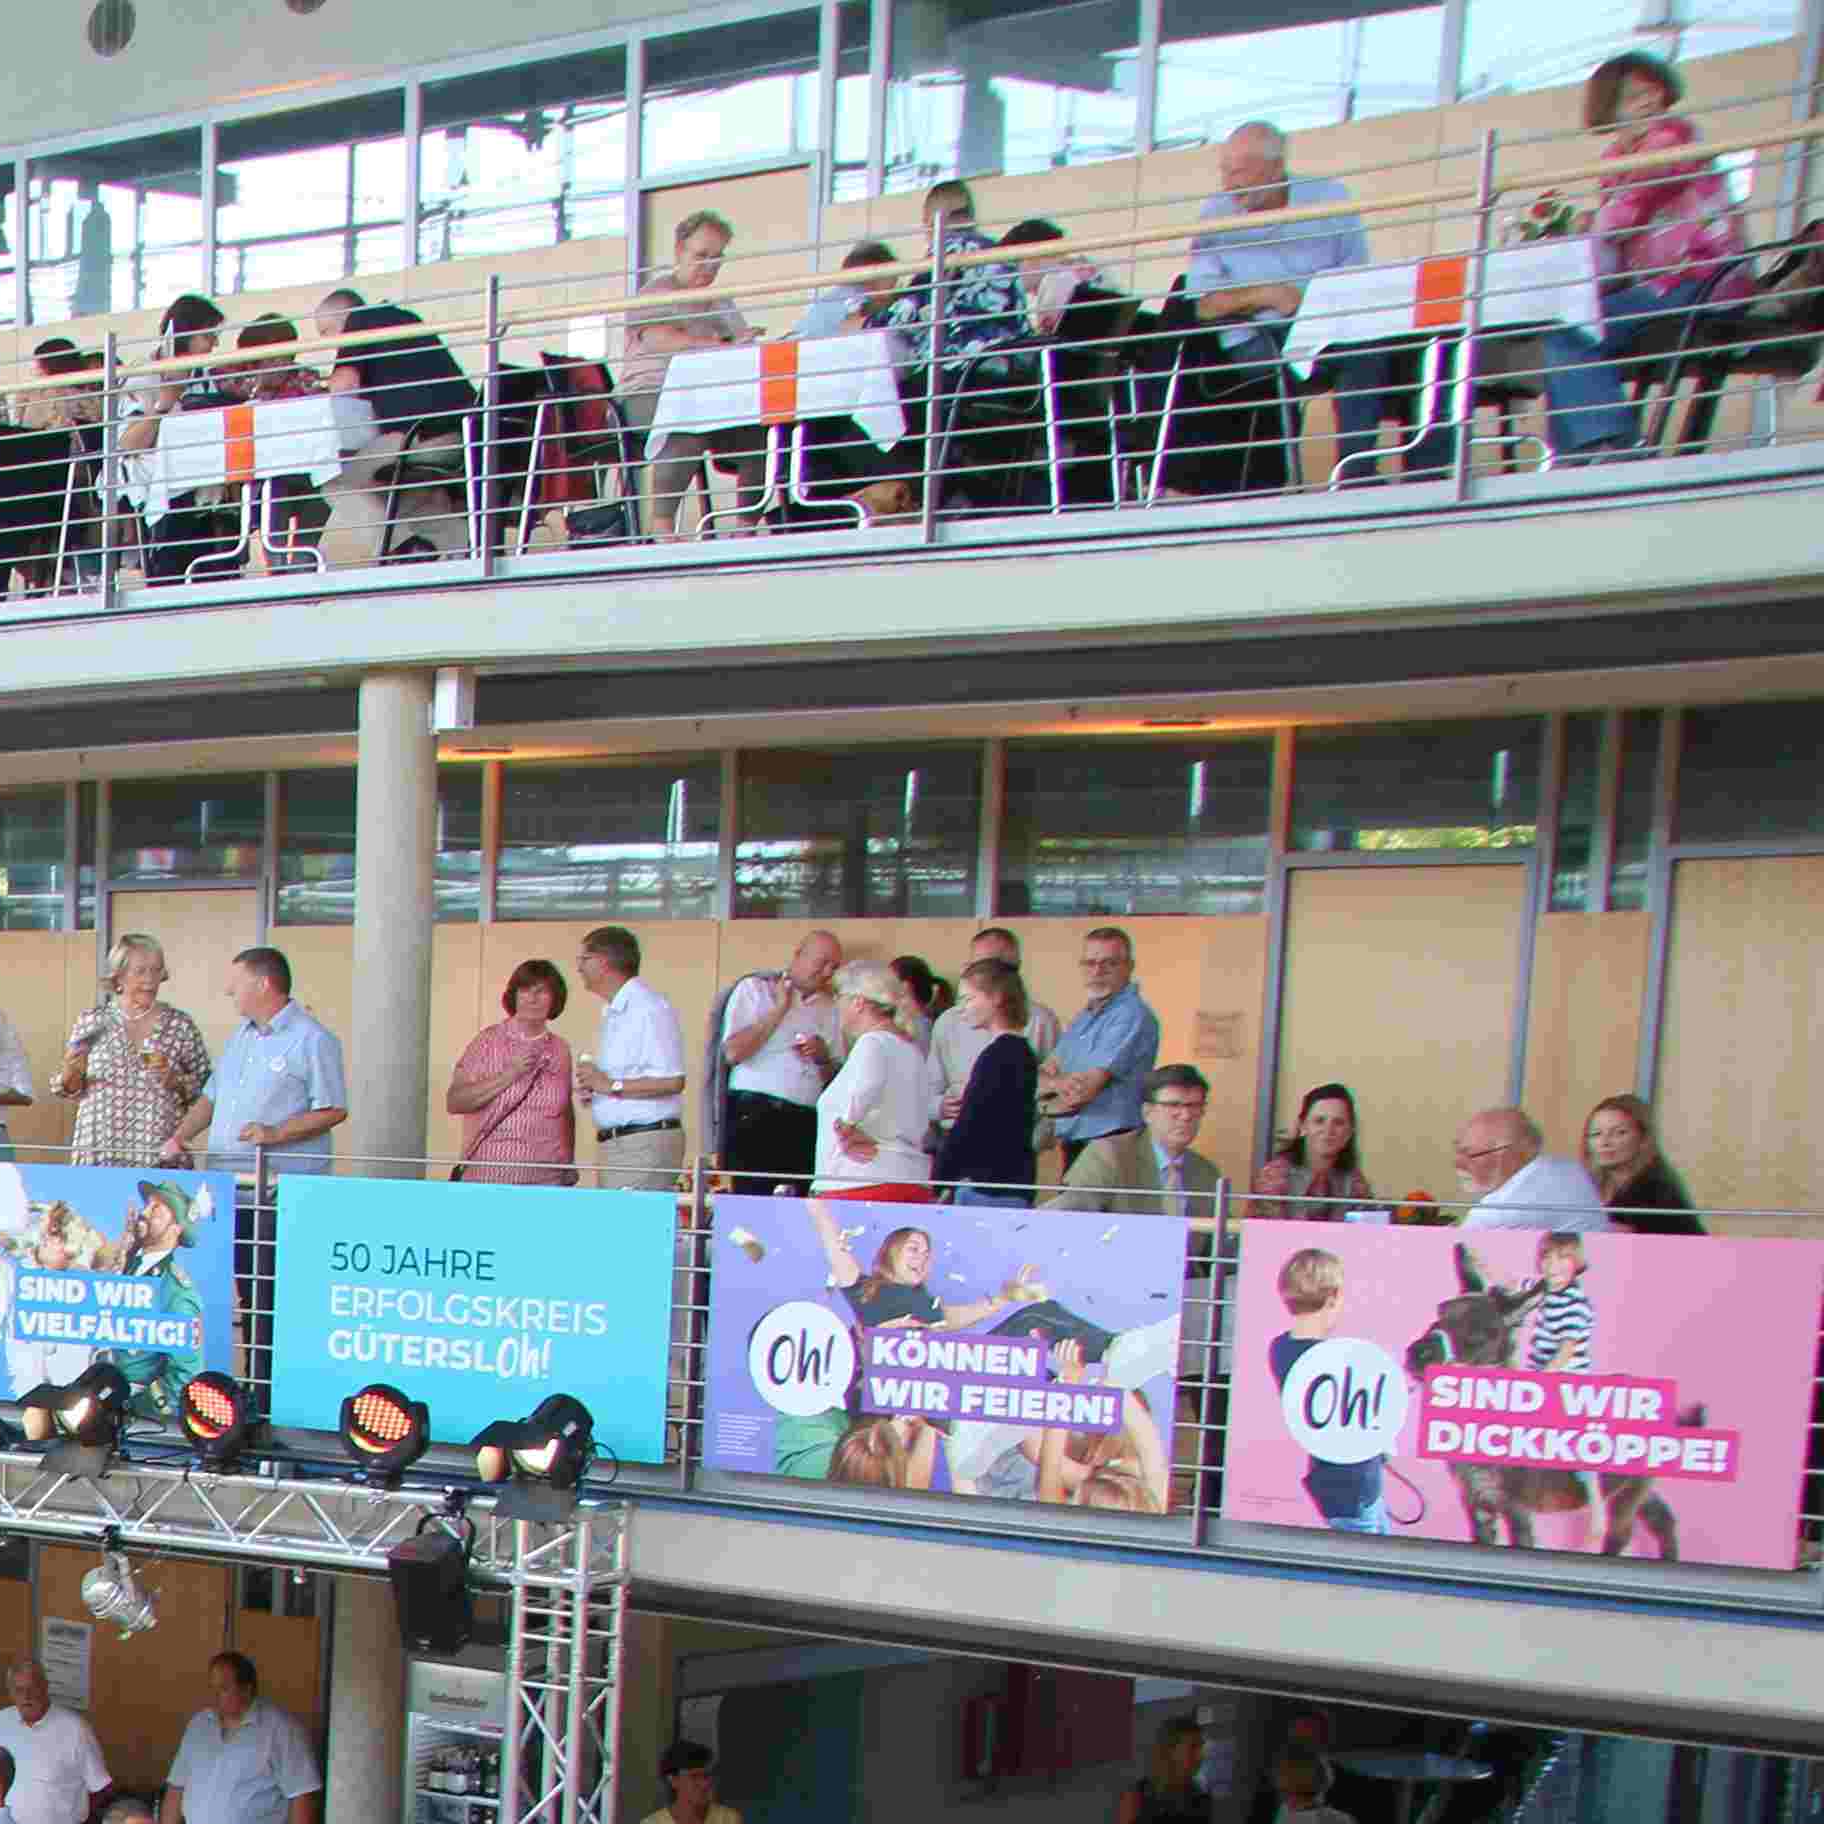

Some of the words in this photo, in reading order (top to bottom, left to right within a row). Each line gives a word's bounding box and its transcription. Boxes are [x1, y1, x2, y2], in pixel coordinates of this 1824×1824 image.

[330, 1242, 371, 1273] 50
[381, 1244, 496, 1281] JAHRE
[18, 1276, 87, 1303] SIND
[94, 1281, 152, 1308] WIR
[328, 1283, 609, 1336] ERFOLGSKREIS
[18, 1311, 187, 1346] VIELFÄLTIG!
[767, 1328, 835, 1387] Oh!
[871, 1331, 1039, 1377] KÖNNEN
[870, 1377, 950, 1412] WIR
[959, 1385, 1116, 1425] FEIERN!
[1303, 1365, 1388, 1431] Oh!
[1429, 1375, 1545, 1413] SIND
[1559, 1382, 1664, 1422] WIR
[1427, 1420, 1729, 1474] DICKKÖPPE!
